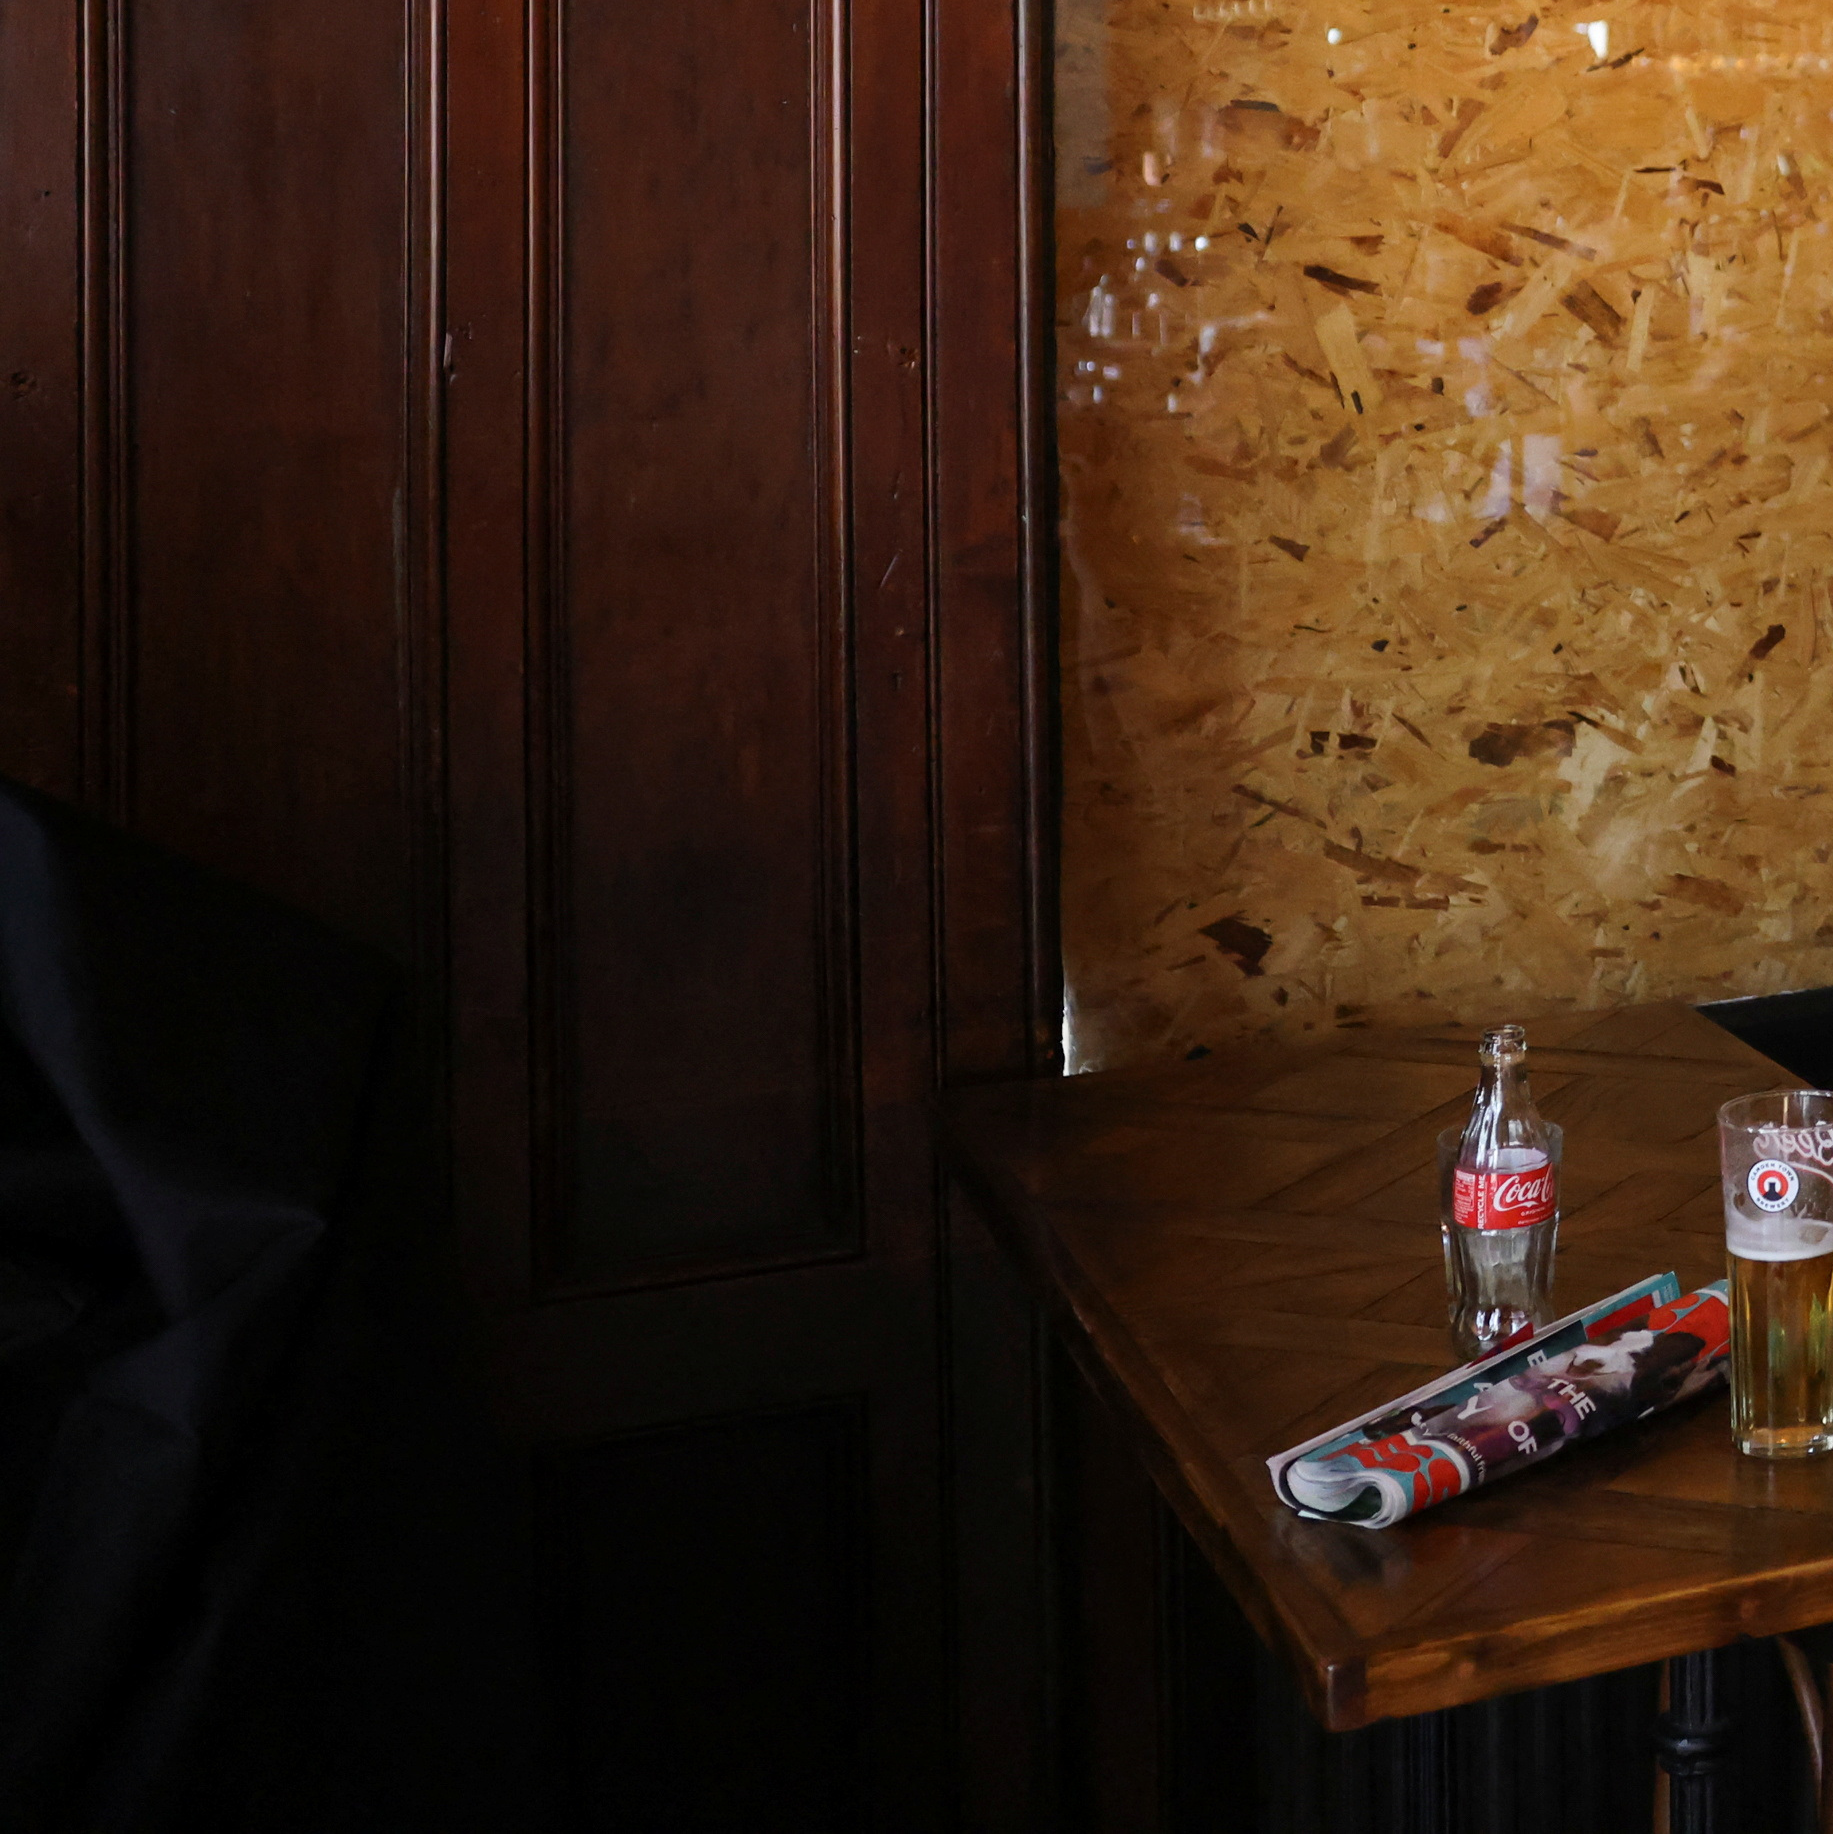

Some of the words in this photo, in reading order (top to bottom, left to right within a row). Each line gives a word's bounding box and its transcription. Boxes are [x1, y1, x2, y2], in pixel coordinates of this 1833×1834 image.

[1479, 1174, 1487, 1189] ME
[1777, 1162, 1796, 1182] TOWN
[1477, 1191, 1486, 1229] RECYCLE
[1755, 1196, 1790, 1210] BREWERY
[1546, 1377, 1597, 1422] THE
[1507, 1419, 1538, 1455] OF
